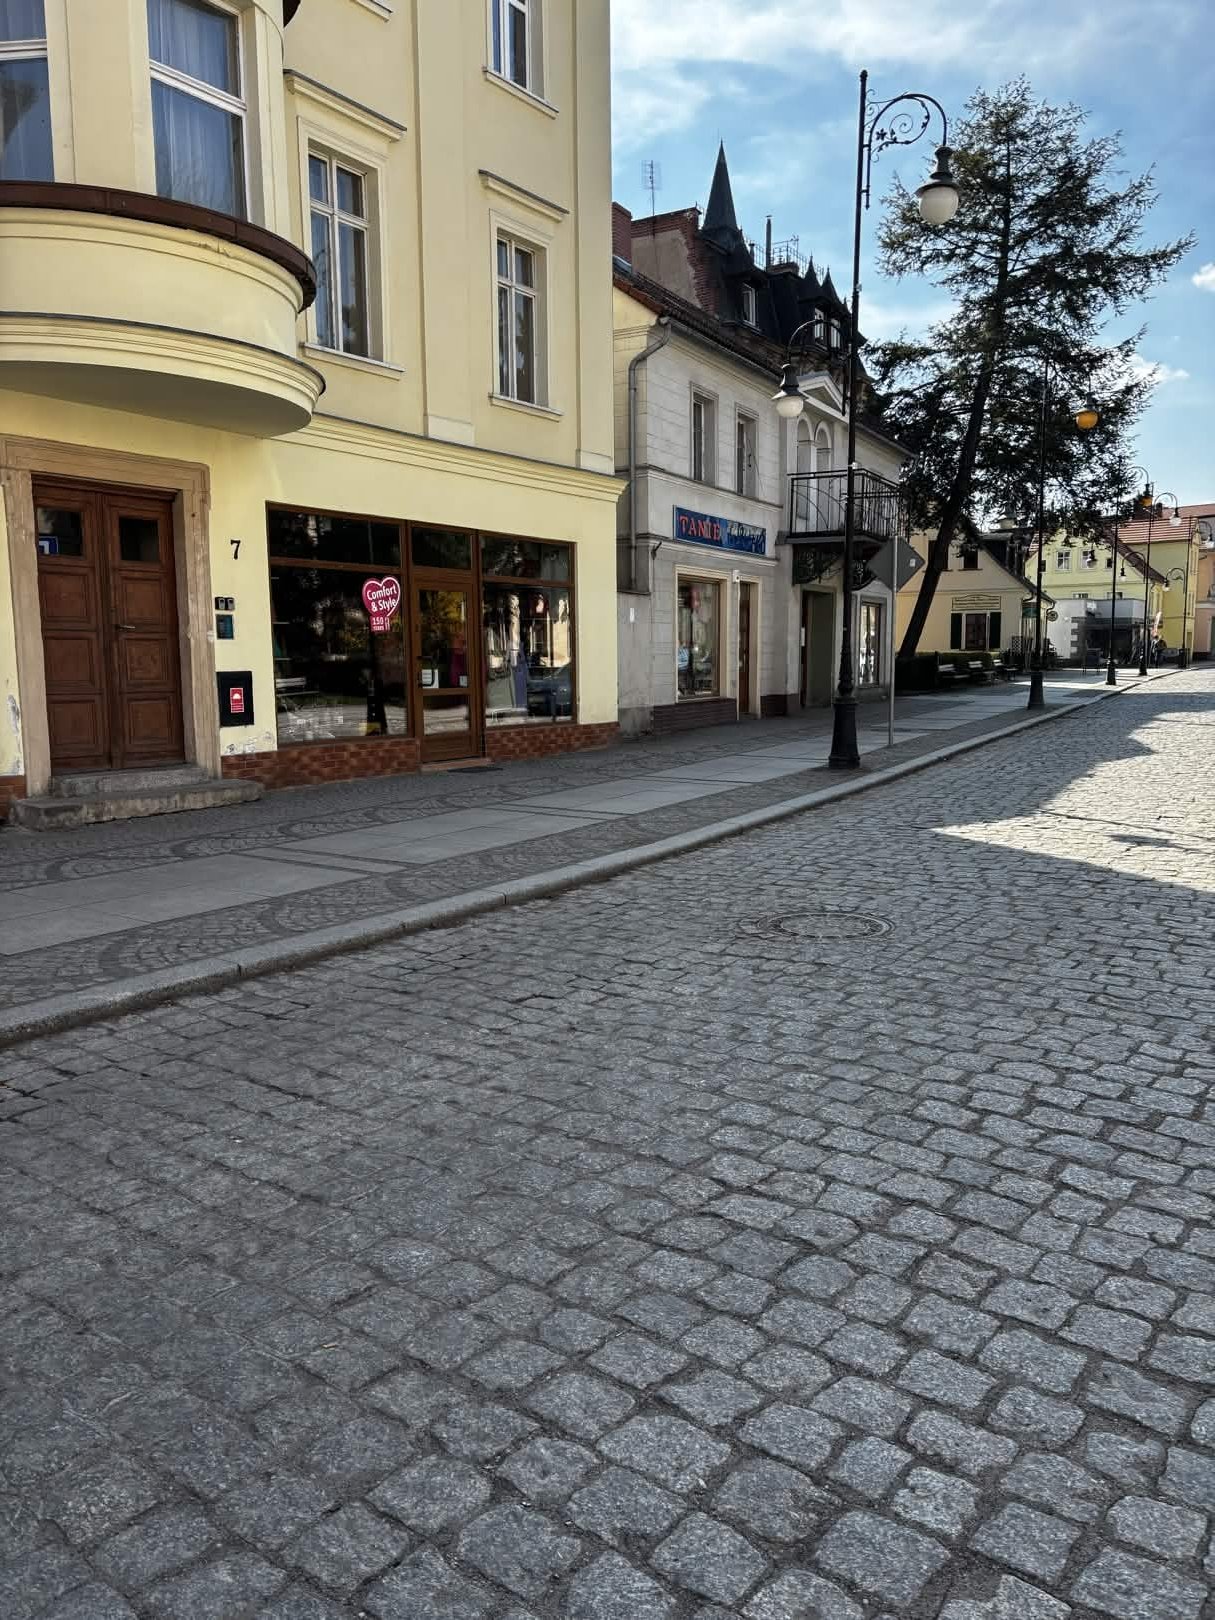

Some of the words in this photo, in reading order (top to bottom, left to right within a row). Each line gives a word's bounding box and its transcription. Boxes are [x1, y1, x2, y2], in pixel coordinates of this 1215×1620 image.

[679, 515, 721, 540] TANIE
[230, 539, 241, 560] 7
[366, 584, 397, 601] Comfort
[371, 601, 378, 612] &
[378, 597, 397, 612] Style
[372, 616, 384, 625] 150
